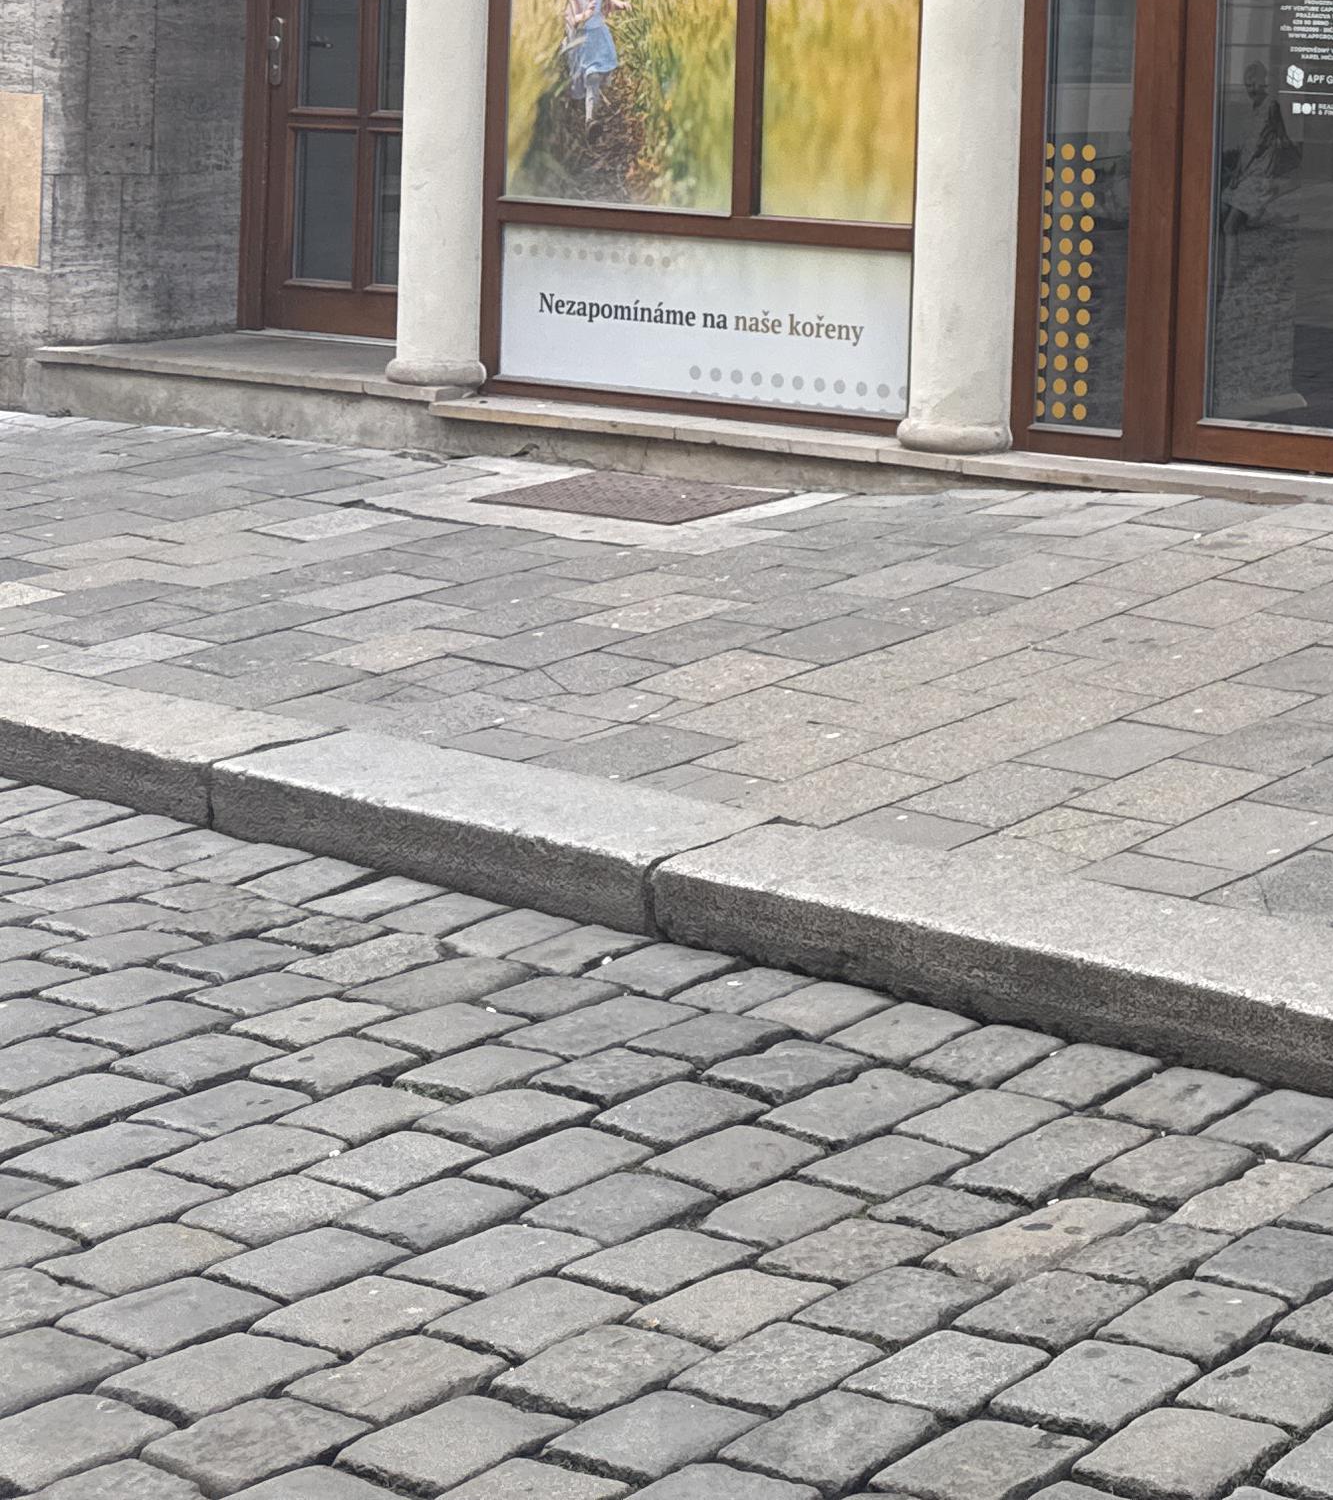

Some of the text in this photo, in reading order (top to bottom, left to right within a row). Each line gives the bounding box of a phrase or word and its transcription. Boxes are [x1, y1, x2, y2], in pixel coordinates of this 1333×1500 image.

[1307, 74, 1325, 83] APF
[539, 292, 864, 347] Nezapomínáme na naše kořeny
